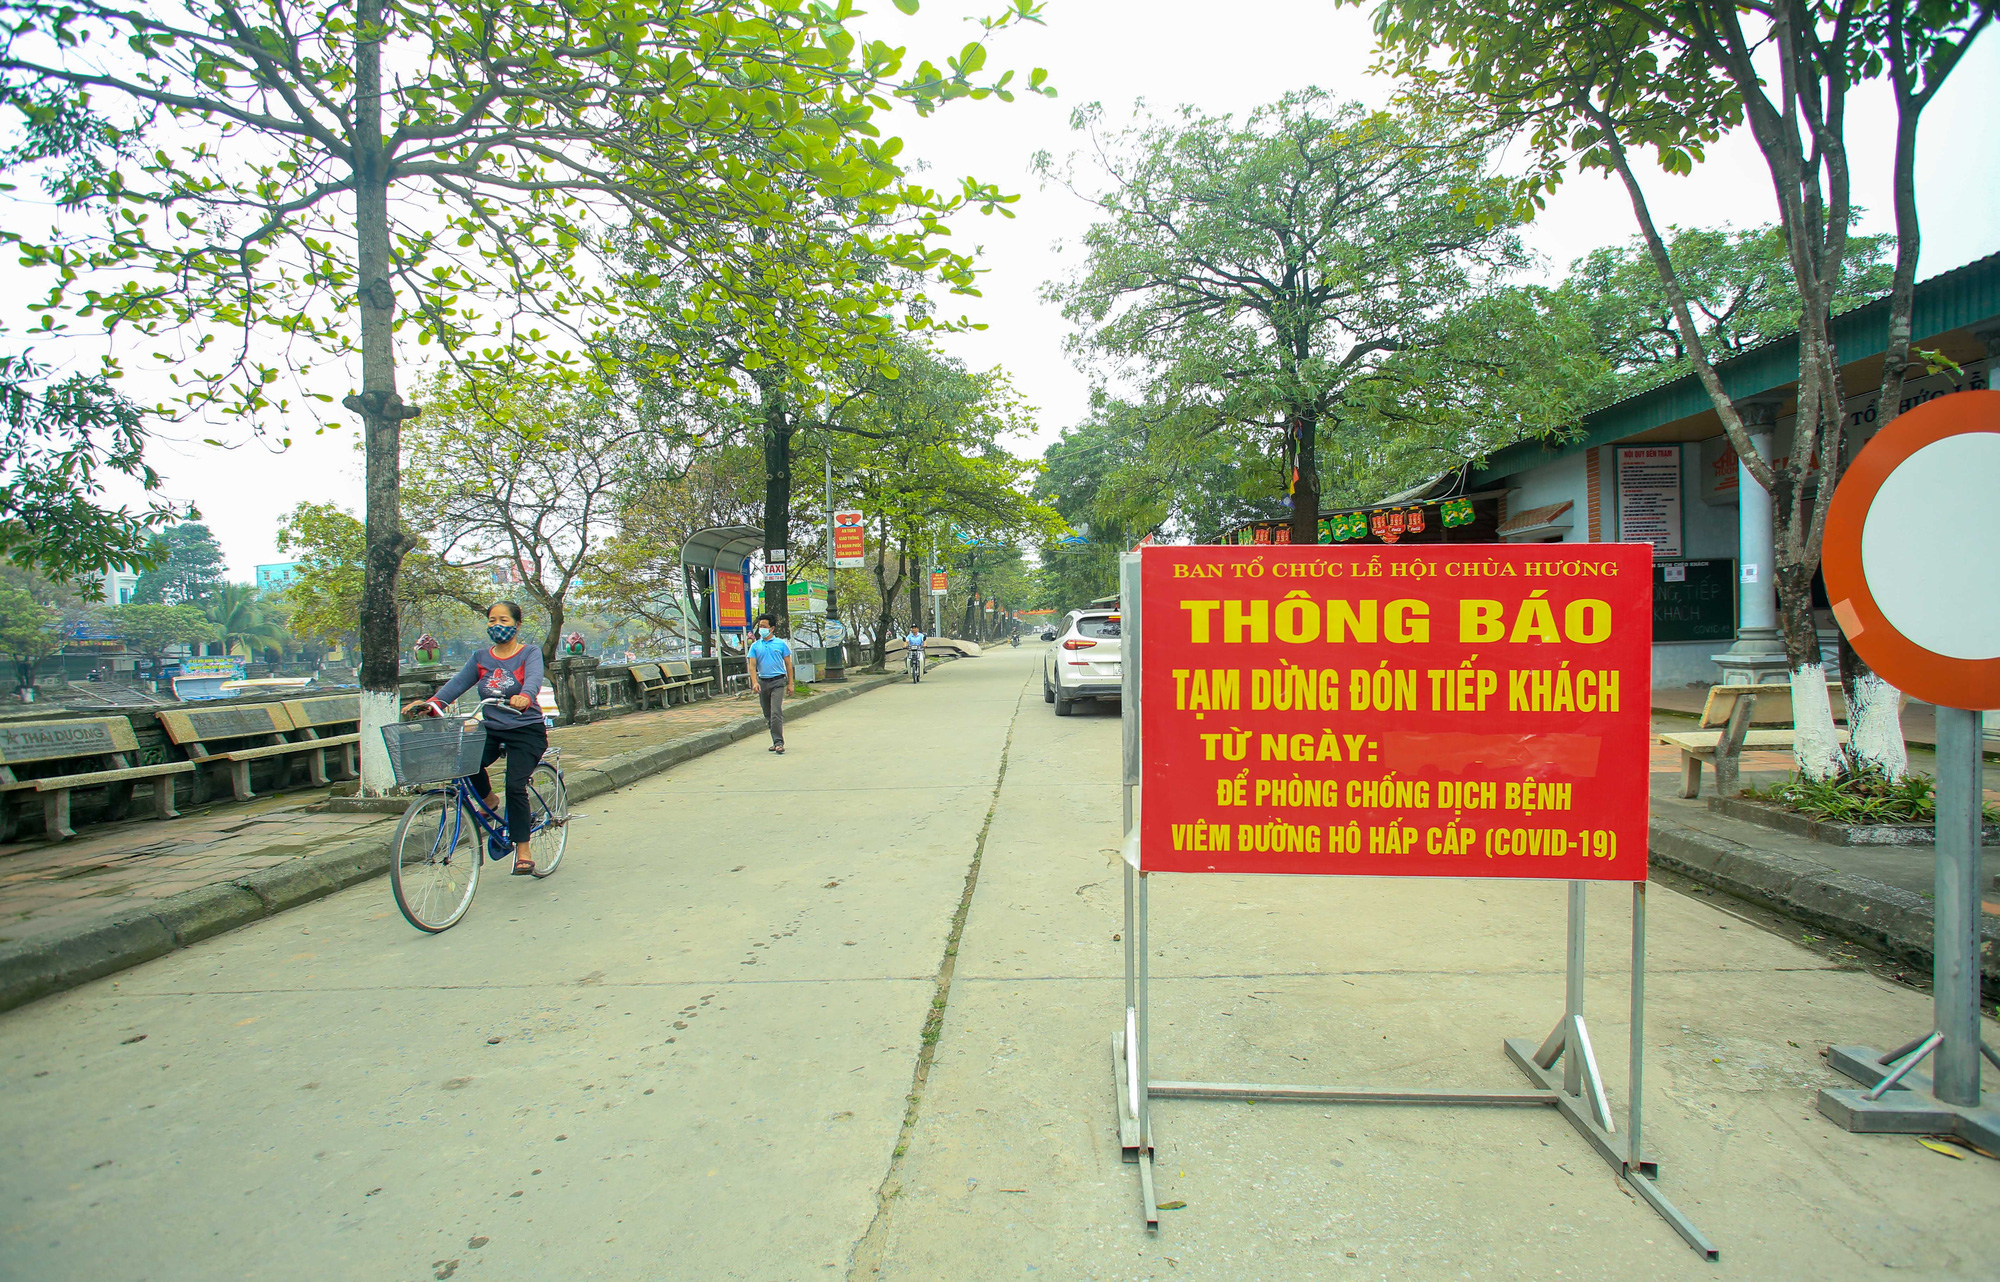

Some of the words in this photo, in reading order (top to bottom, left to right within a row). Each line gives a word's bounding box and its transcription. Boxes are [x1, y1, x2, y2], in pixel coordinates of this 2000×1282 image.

[764, 564, 784, 574] TAXI
[1173, 563, 1225, 579] BAN
[1231, 555, 1265, 578] TỔ
[1272, 558, 1343, 578] CHỨC
[1351, 554, 1383, 577] LỄ
[1392, 557, 1436, 581] HỘI
[1445, 557, 1518, 577] CHÙA
[1525, 559, 1619, 577] HƯƠNG
[1682, 573, 1721, 601] TIẾP
[1180, 590, 1430, 644] THÔNG
[1460, 589, 1612, 644] BÁO
[1653, 599, 1700, 622] KHÁCH
[1172, 668, 1241, 721] TẠM
[1252, 658, 1339, 712] DỪNG
[1349, 659, 1417, 712] ĐÓN
[1428, 653, 1498, 712] TIẾP
[1509, 660, 1620, 713] KHÁCH
[1200, 726, 1253, 762] TỪ
[1260, 727, 1378, 763] NGÀY:
[1217, 767, 1250, 807] ĐỂ
[1256, 772, 1338, 808] PHÒNG
[1346, 770, 1430, 809] CHỐNG
[1437, 781, 1497, 815] DỊCH
[1505, 776, 1572, 817] BỆNH
[1171, 818, 1231, 852] VIÊM
[1238, 817, 1321, 854] ĐƯỜNG
[1329, 819, 1362, 854] HÔ
[1369, 816, 1419, 855] HẤP
[1427, 816, 1477, 855] CẤP
[1485, 828, 1617, 861] (COVID-19)
